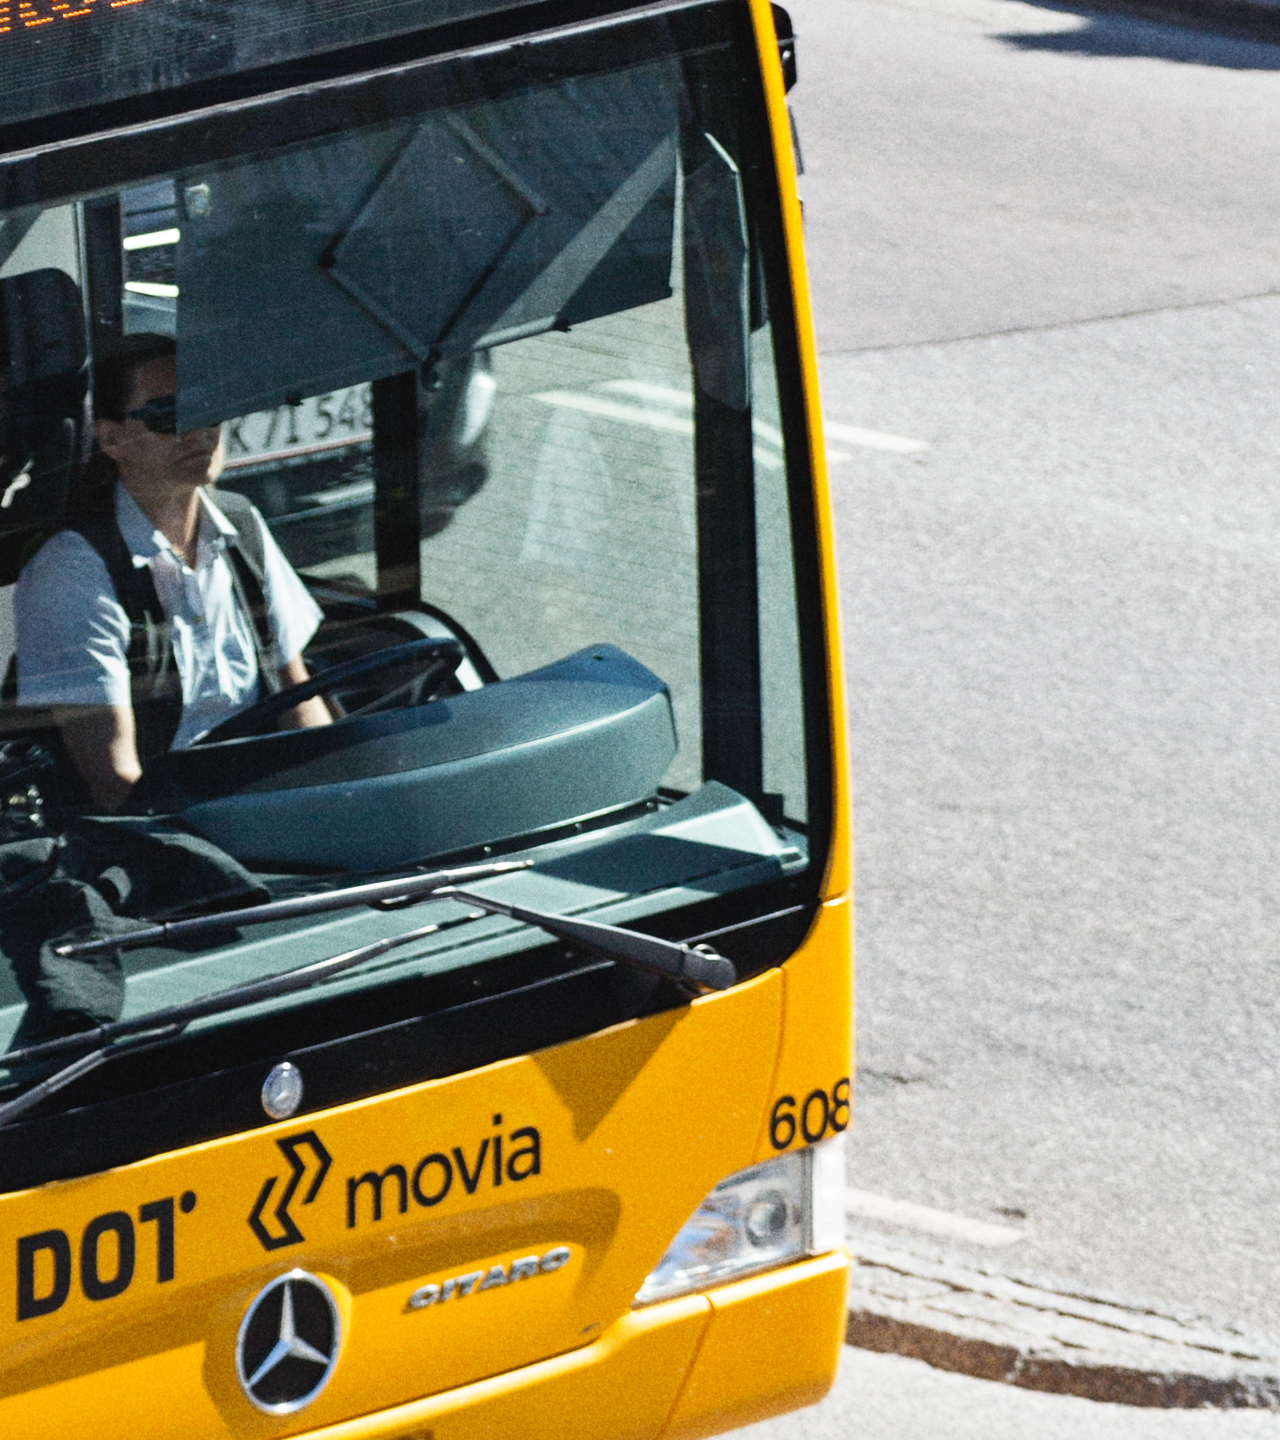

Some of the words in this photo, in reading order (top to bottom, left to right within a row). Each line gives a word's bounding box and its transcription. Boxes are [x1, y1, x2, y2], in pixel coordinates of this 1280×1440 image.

[769, 1076, 851, 1151] 608
[346, 1112, 541, 1230] movia
[16, 1190, 196, 1323] DOT
[407, 1245, 572, 1310] CITARO
